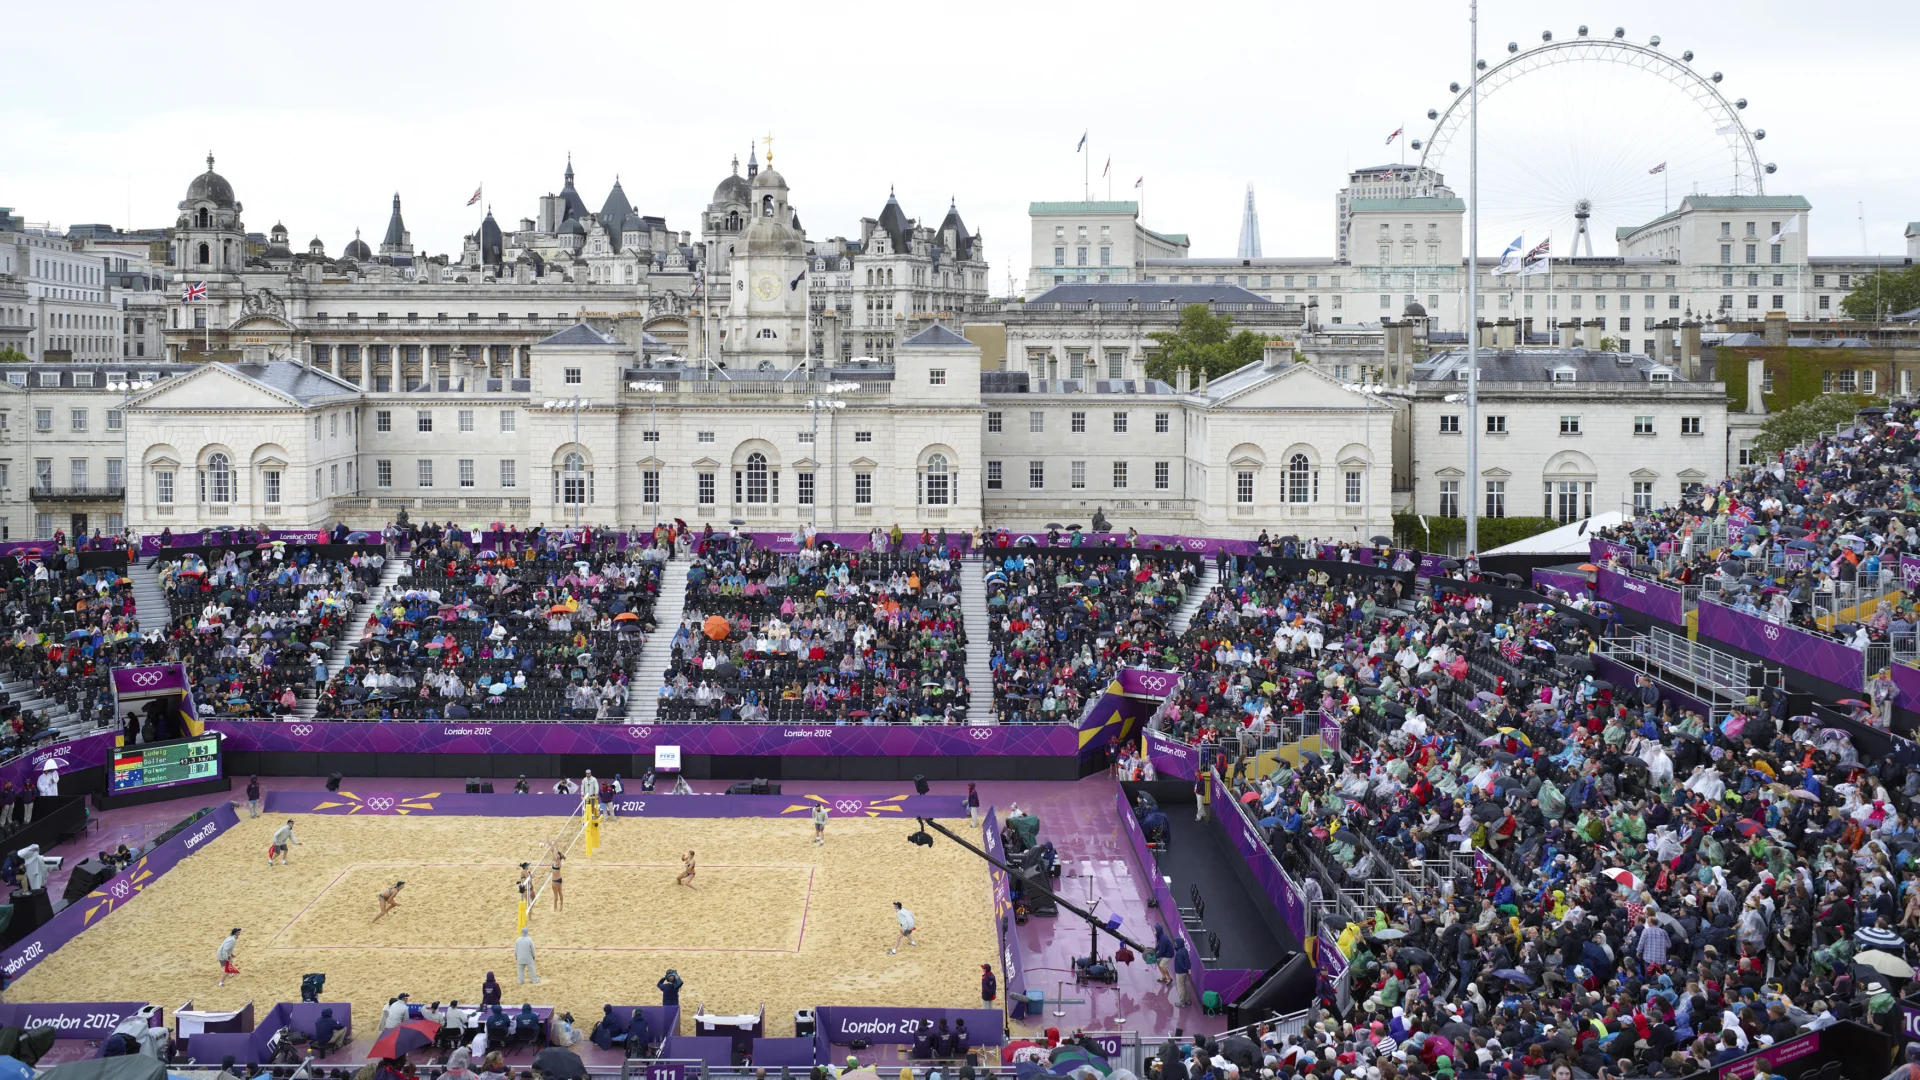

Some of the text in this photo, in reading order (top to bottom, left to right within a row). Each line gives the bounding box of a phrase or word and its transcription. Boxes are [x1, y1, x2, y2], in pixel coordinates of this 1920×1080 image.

[444, 727, 492, 736] London 2012
[783, 729, 833, 738] London 2012
[32, 746, 71, 765] London 2012
[1154, 742, 1187, 759] London 2012
[621, 801, 646, 811] 2012
[184, 821, 217, 849] London 2012
[3, 941, 44, 974] ndon 2012
[24, 1013, 120, 1030] London 2012
[841, 1017, 897, 1034] London
[1097, 1040, 1117, 1054] 10
[653, 1069, 676, 1080] 111
